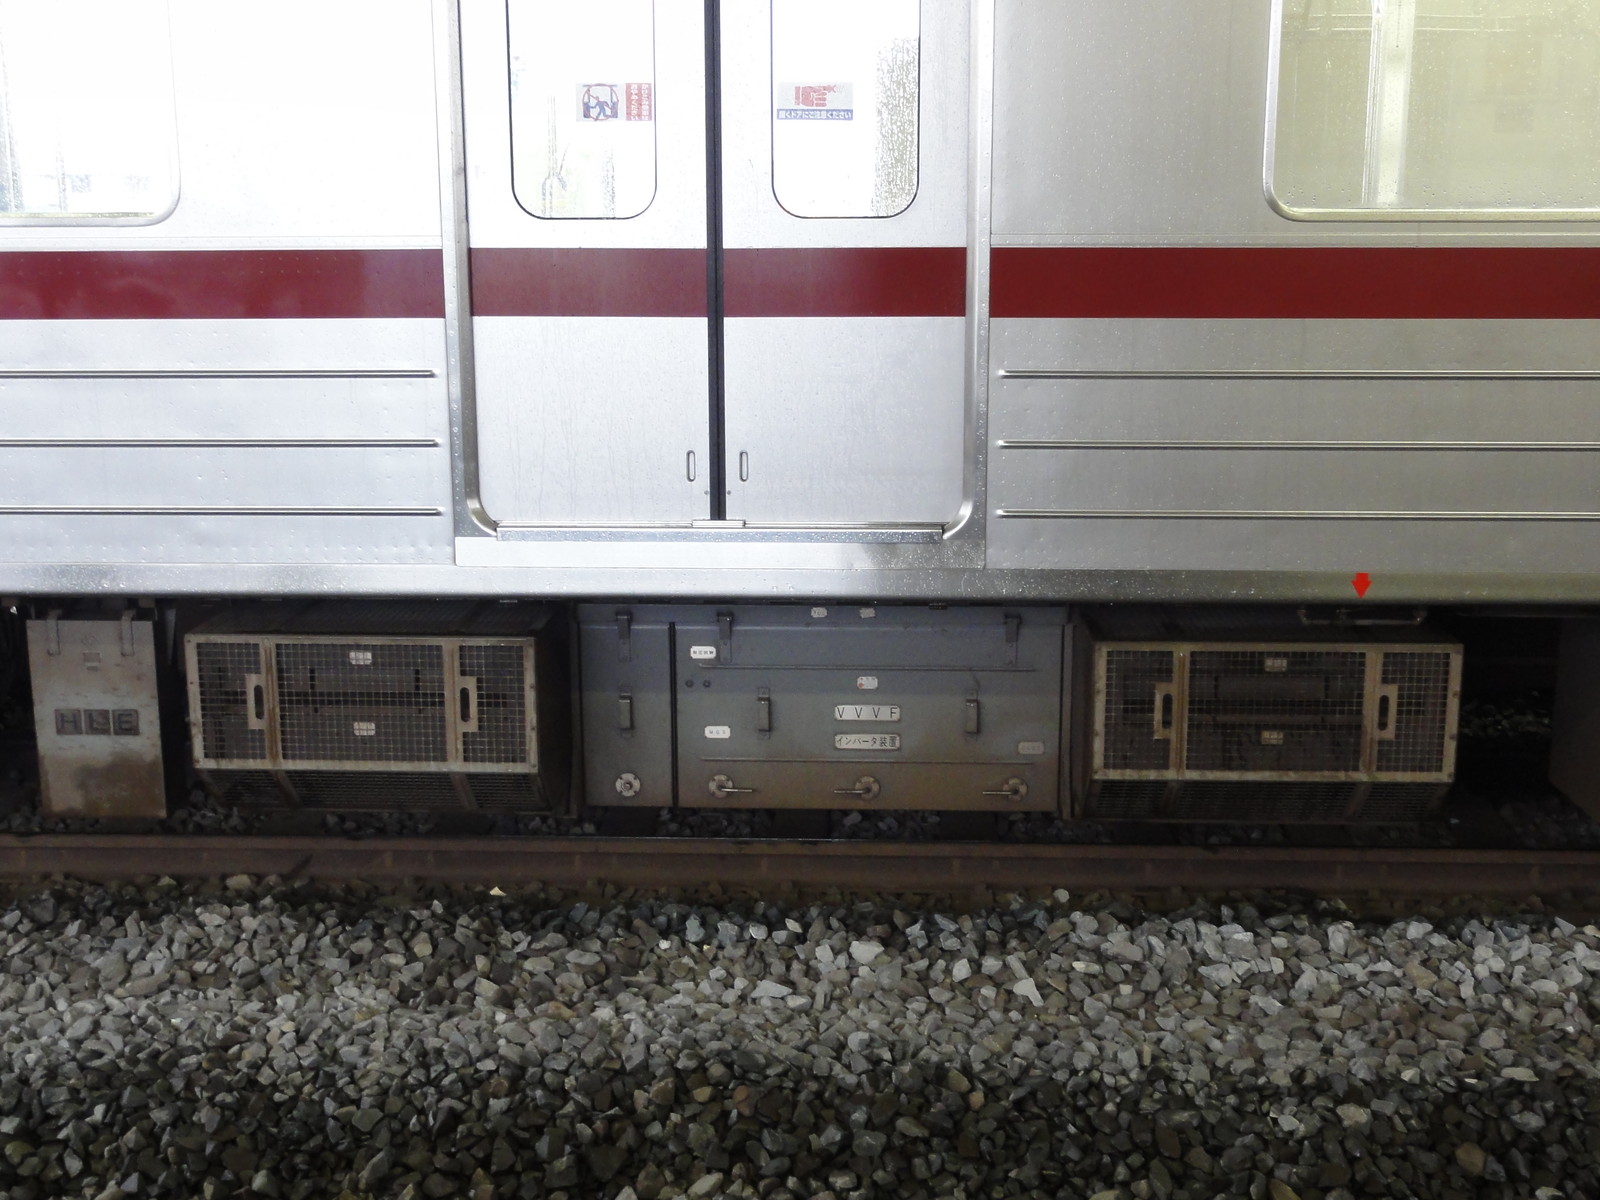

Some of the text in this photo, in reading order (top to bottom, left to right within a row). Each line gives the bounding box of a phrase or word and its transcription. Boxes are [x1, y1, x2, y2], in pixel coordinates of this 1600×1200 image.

[836, 735, 897, 748] インバータ装置
